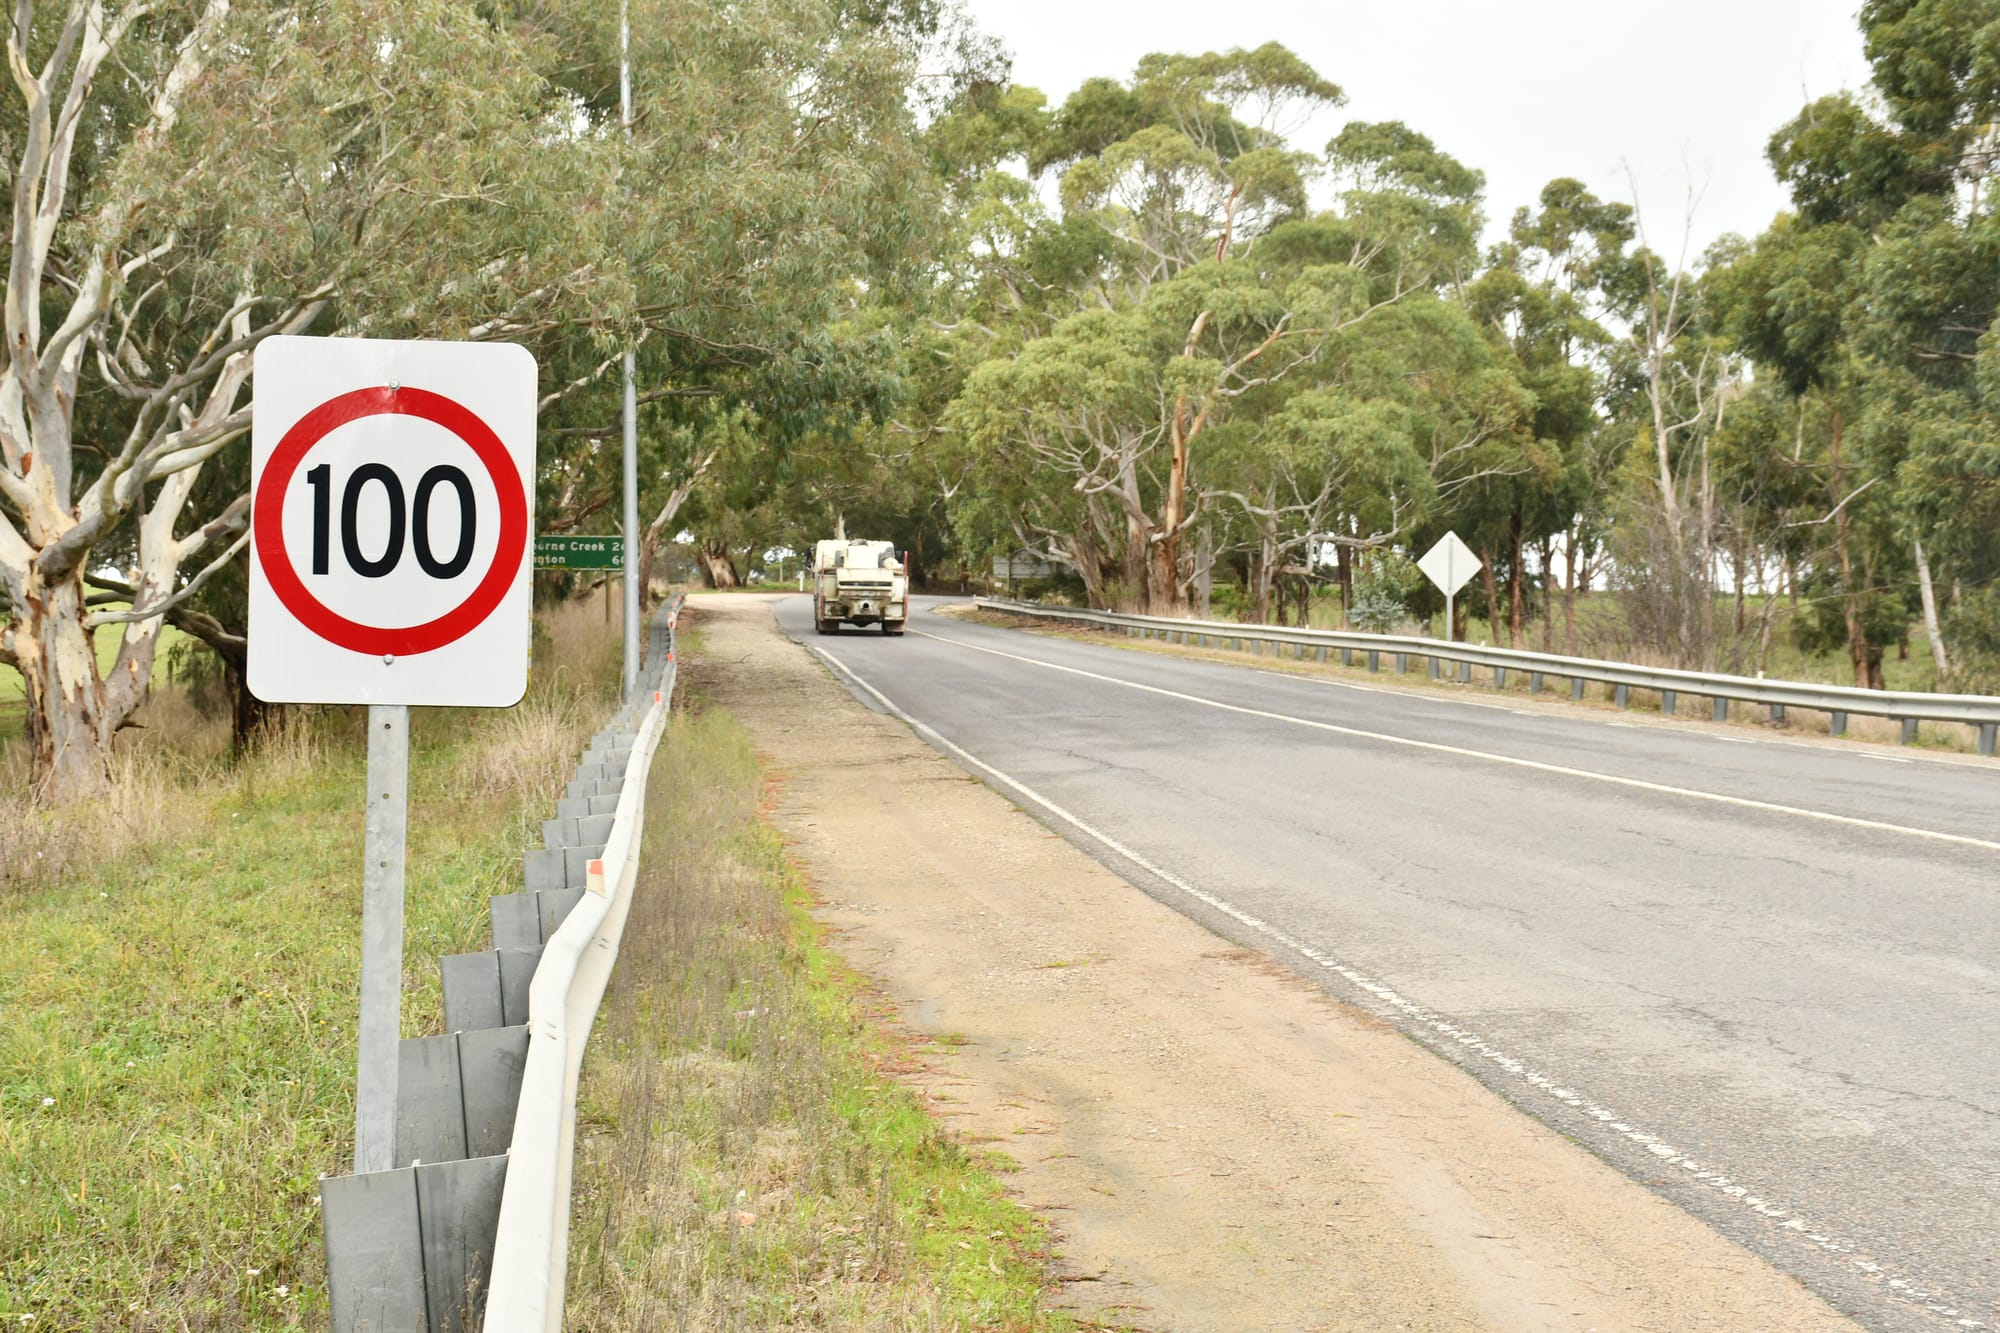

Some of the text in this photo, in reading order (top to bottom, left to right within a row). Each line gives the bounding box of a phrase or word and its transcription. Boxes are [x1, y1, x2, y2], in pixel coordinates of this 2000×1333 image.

[307, 462, 476, 580] 100
[534, 543, 566, 551] orne
[570, 541, 606, 551] Creek
[534, 553, 566, 566] gton
